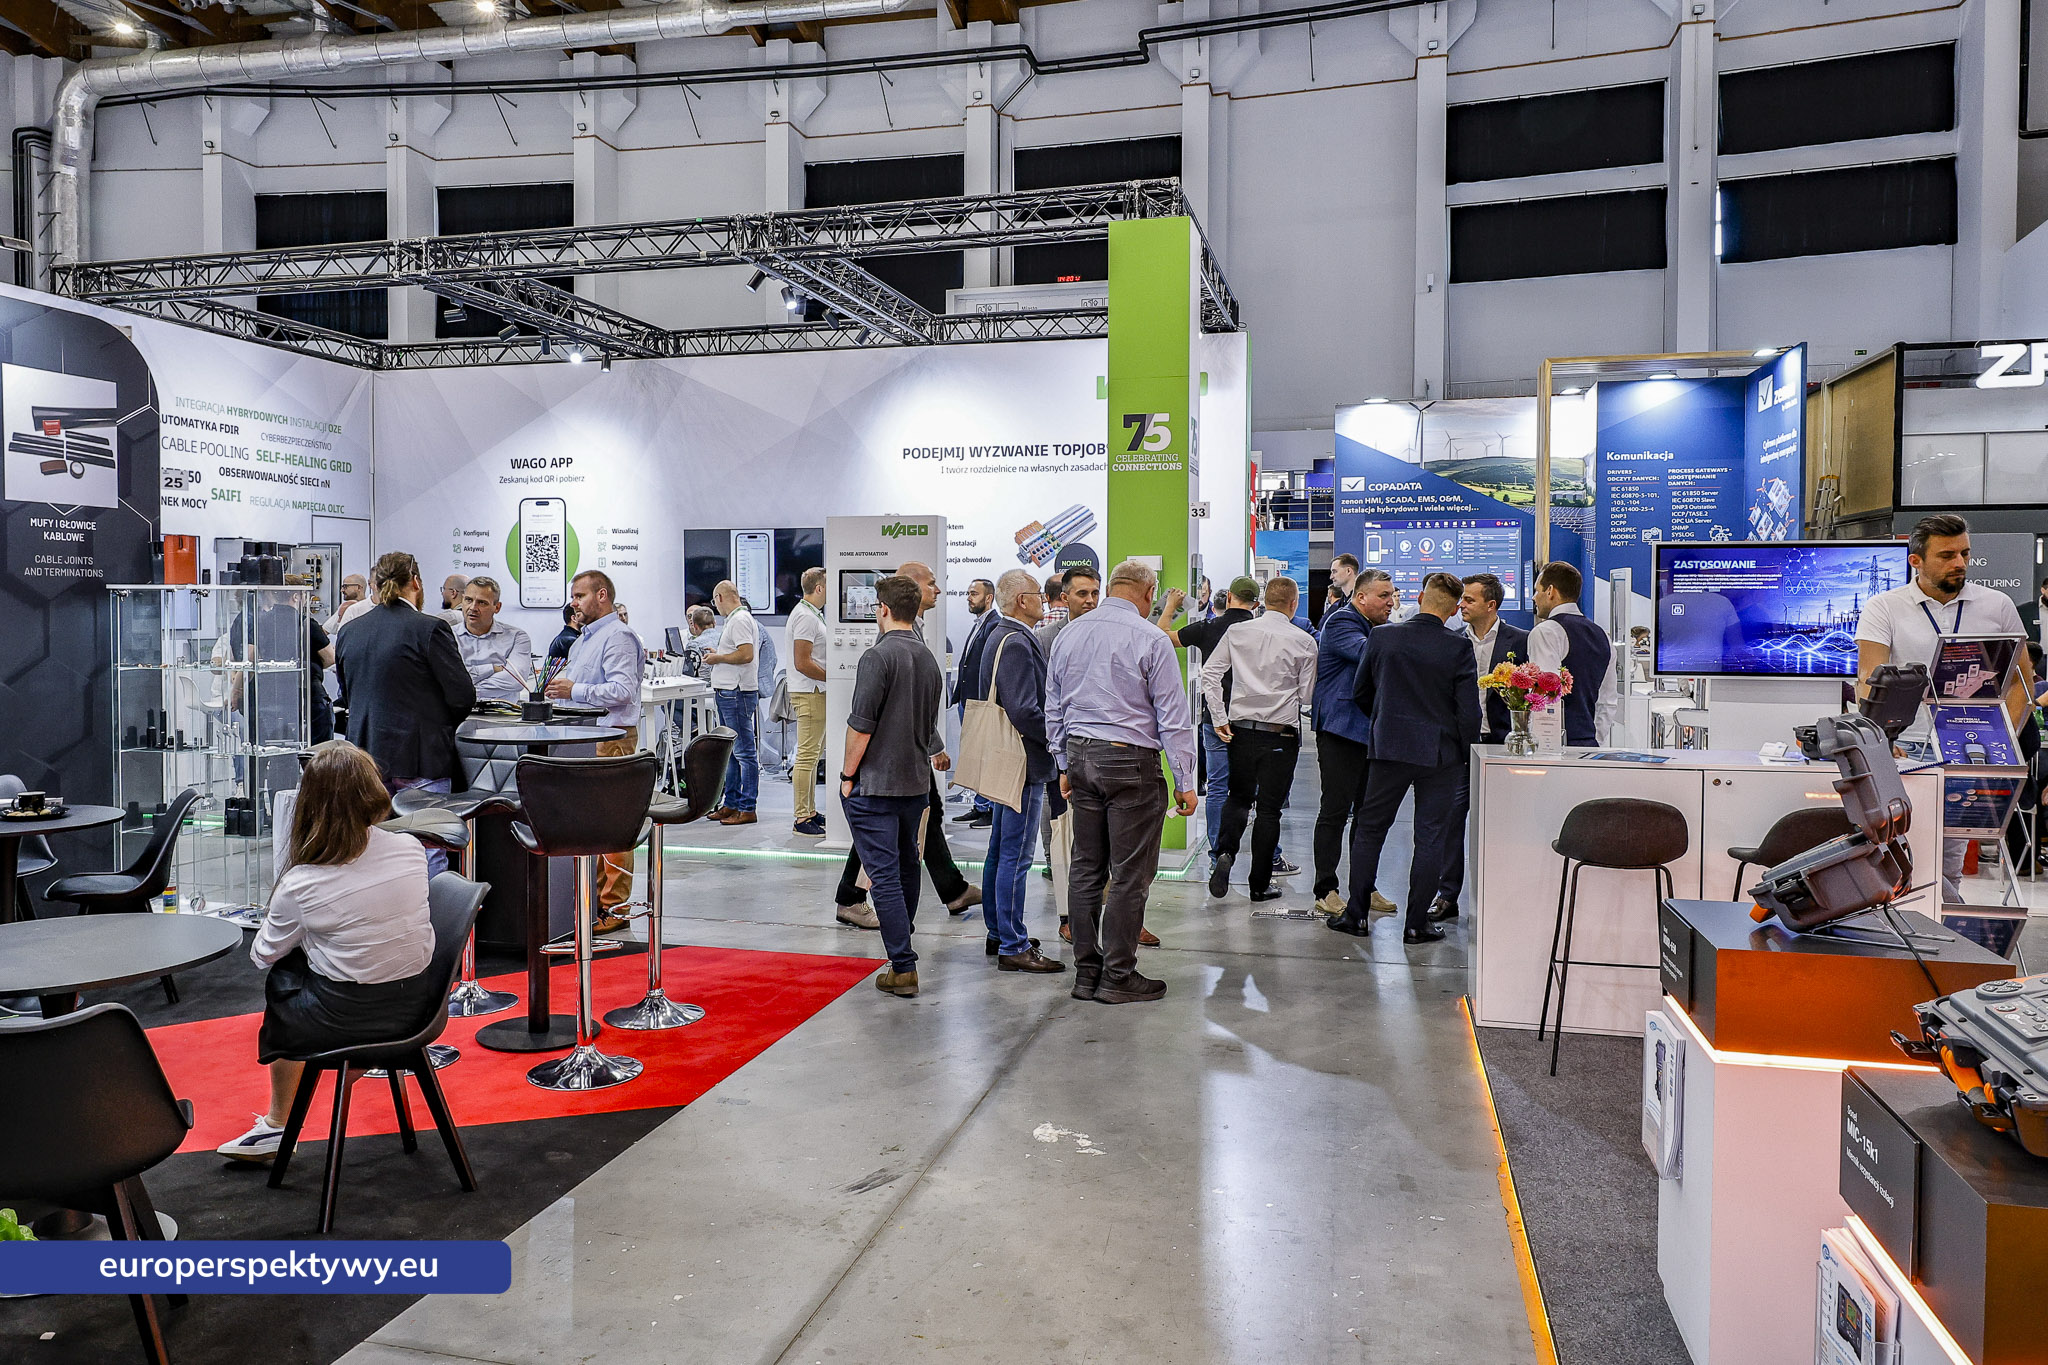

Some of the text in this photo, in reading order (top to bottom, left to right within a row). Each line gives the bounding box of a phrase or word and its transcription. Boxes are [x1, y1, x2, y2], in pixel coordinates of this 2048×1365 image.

[176, 396, 342, 434] INTEGRACJA HYBRYDOWYCH INSTALACJI OZE
[160, 414, 240, 435] UTOMATYKA FDIR
[1122, 412, 1172, 452] 75
[260, 432, 332, 451] CYBERBEZPIECZEŃSTWO
[161, 436, 249, 460] CABLE POOLING
[903, 447, 965, 461] PODEJMIJ
[969, 445, 1049, 458] WYZWANIE
[256, 449, 352, 473] SELF-HEALING GRID
[1115, 453, 1179, 462] CELEBRATING
[1606, 451, 1674, 461] Komunikacja
[510, 457, 573, 469] WAGO APP
[1112, 462, 1182, 472] CONNECTIONS
[946, 466, 969, 474] twórz
[970, 465, 1017, 473] rozdzielnice
[1030, 464, 1069, 473] własnych
[164, 477, 183, 488] 25
[219, 466, 330, 488] OBSERWOWALNOŚĆ SIECI nN
[499, 476, 529, 485] Zeskanuj
[530, 475, 543, 483] kod
[544, 475, 555, 483] QR
[559, 474, 585, 484] pobierz
[211, 487, 241, 502] SAIFI
[1385, 496, 1416, 504] SCADA,
[1439, 495, 1463, 503] O&M,
[161, 496, 207, 509] NEK MOCY
[250, 496, 345, 514] REGULACJA NAPIĘCIA OLTC
[1191, 508, 1205, 517] 33
[1341, 506, 1376, 514] instalacje
[1377, 505, 1419, 514] hybrydowe
[30, 518, 54, 528] MUFY
[60, 520, 97, 531] GŁOWICE
[881, 521, 928, 539] WAGO
[43, 531, 85, 542] KABLOWE
[463, 530, 490, 538] Konfiguruj
[611, 527, 639, 535] Wizualizuj
[463, 545, 485, 553] Aktywuj
[611, 543, 639, 551] Diagnozuj
[34, 555, 94, 565] CABLE JOINTS
[463, 561, 490, 569] Programuj
[611, 559, 638, 568] Monitoruj
[1061, 558, 1092, 567] NOWOŚĆ!
[1674, 560, 1756, 569] ZASTOSOWANIE
[1968, 558, 1988, 566] ING
[24, 567, 104, 578] AND TERMINATIONS
[1966, 578, 2021, 588] ACTURING
[1846, 1117, 1878, 1165] MIC-15k1
